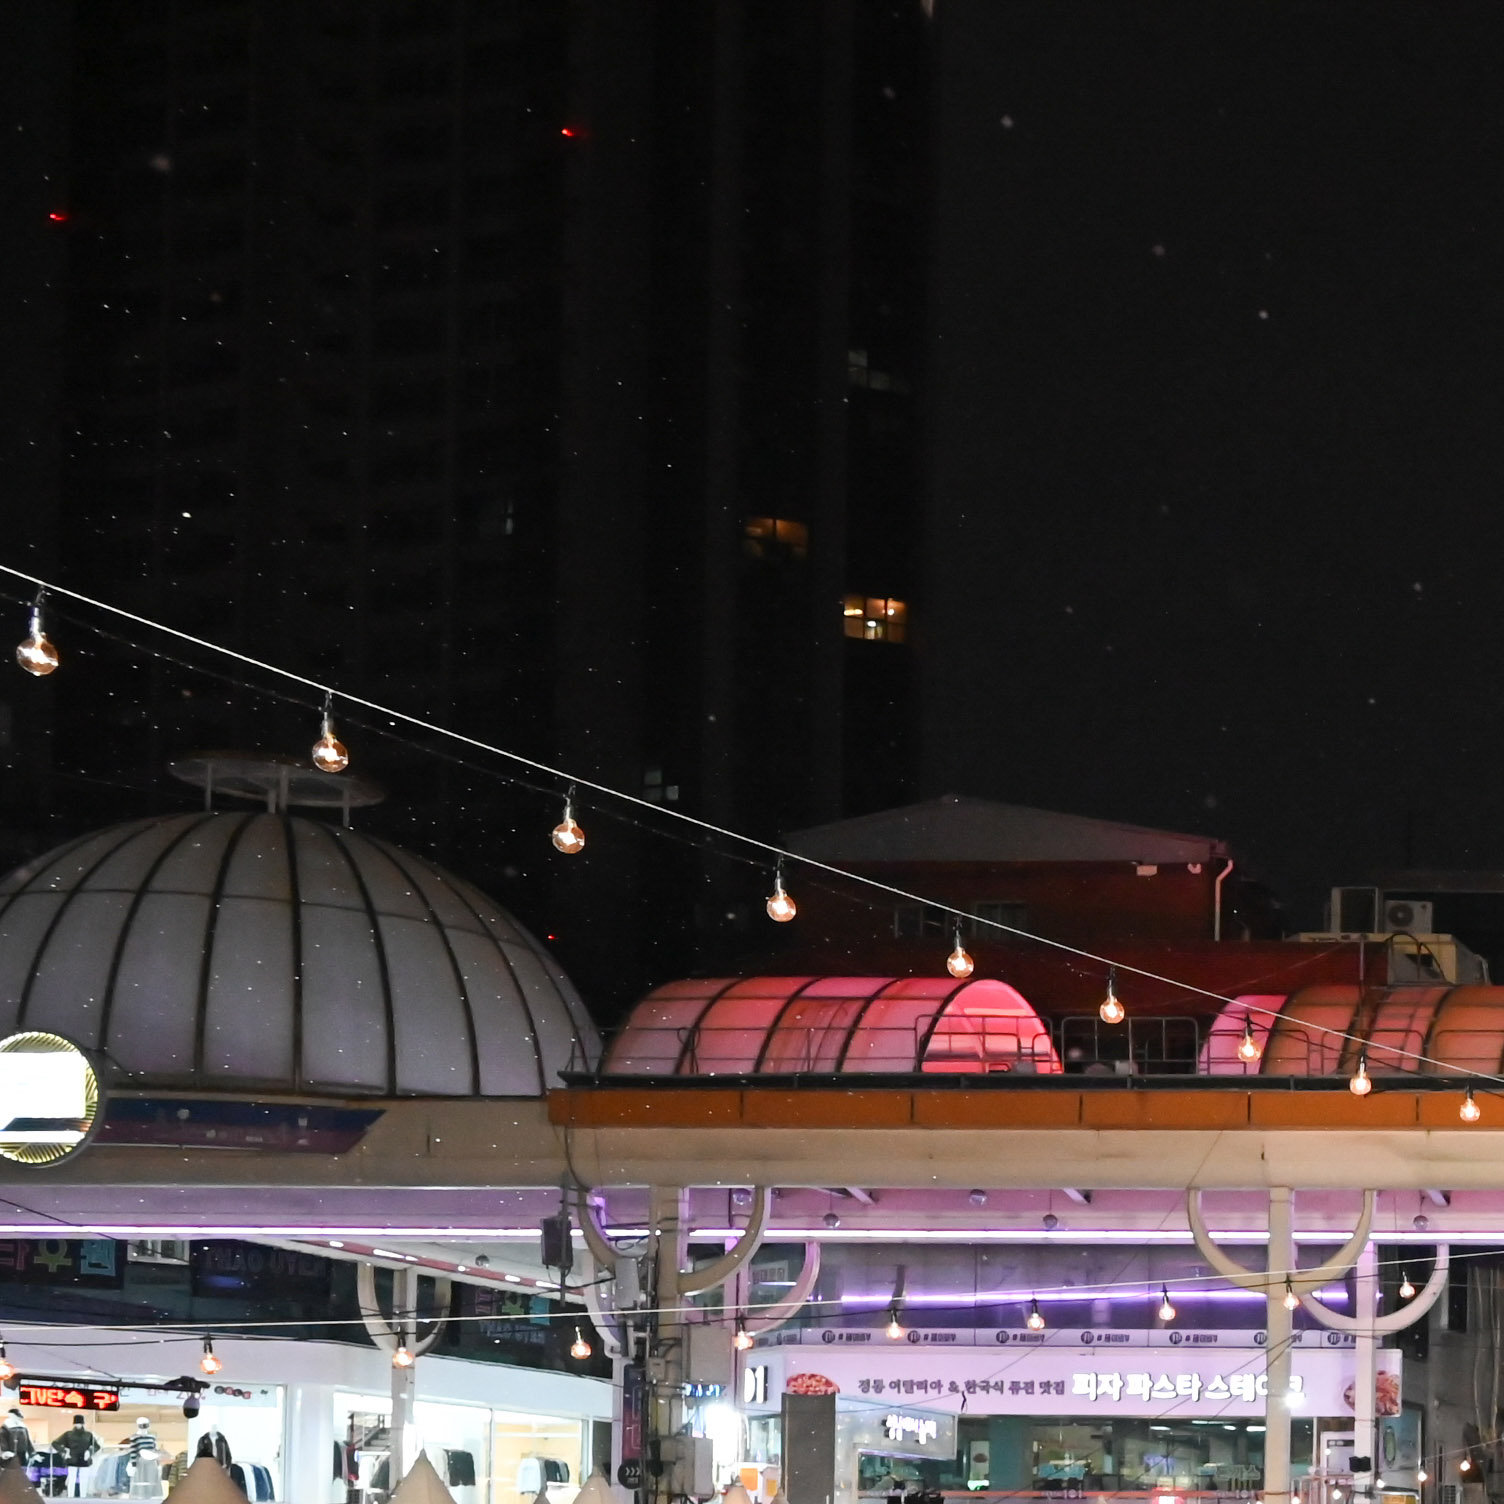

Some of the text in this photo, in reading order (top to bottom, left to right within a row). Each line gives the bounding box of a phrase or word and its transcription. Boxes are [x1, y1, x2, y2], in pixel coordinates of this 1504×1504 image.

[889, 1378, 943, 1395] 이탈리아
[964, 1378, 1004, 1396] 한국식
[1039, 1379, 1065, 1396] 맛집
[1072, 1372, 1124, 1402] 피자
[1126, 1372, 1203, 1402] 파스타
